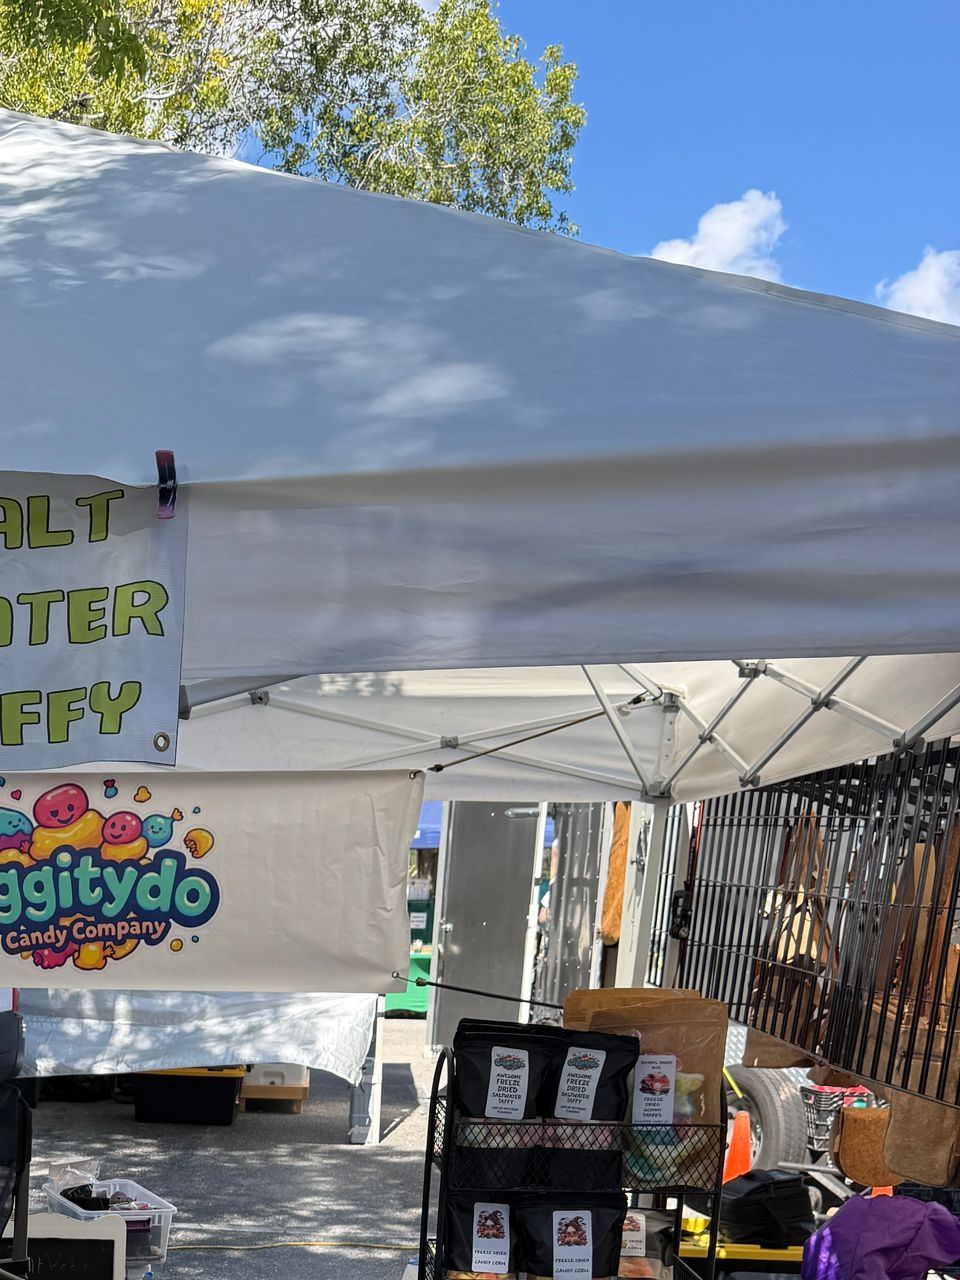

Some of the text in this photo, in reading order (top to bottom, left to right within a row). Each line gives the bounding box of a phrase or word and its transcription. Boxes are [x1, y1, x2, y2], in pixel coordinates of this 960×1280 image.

[5, 919, 166, 948] Candy Company
[566, 1072, 592, 1080] AWESOME
[496, 1079, 521, 1087] FREEZE
[566, 1078, 591, 1087] FREEZE
[491, 1092, 522, 1100] SALTWATER
[561, 1091, 590, 1100] SALTWATER
